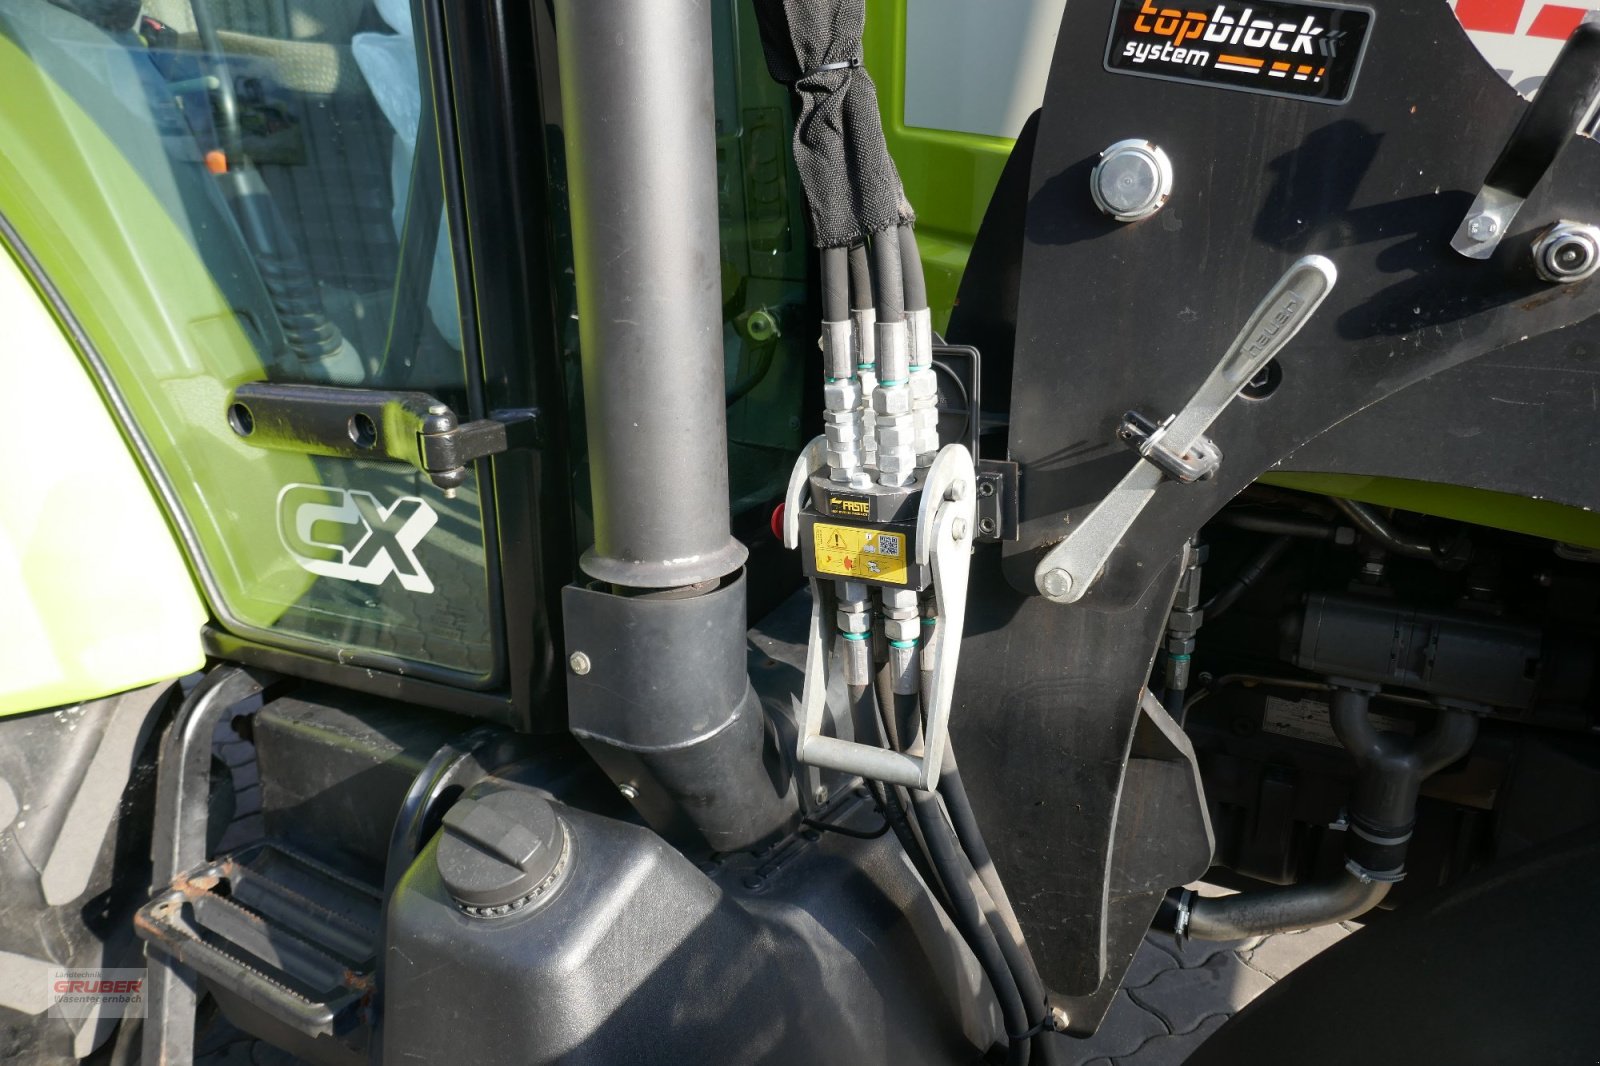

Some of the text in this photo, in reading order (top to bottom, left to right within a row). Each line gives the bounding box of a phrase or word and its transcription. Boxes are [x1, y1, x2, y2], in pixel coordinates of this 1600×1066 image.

[1123, 41, 1209, 67] system
[1134, 0, 1324, 54] topblock
[276, 482, 438, 594] CX
